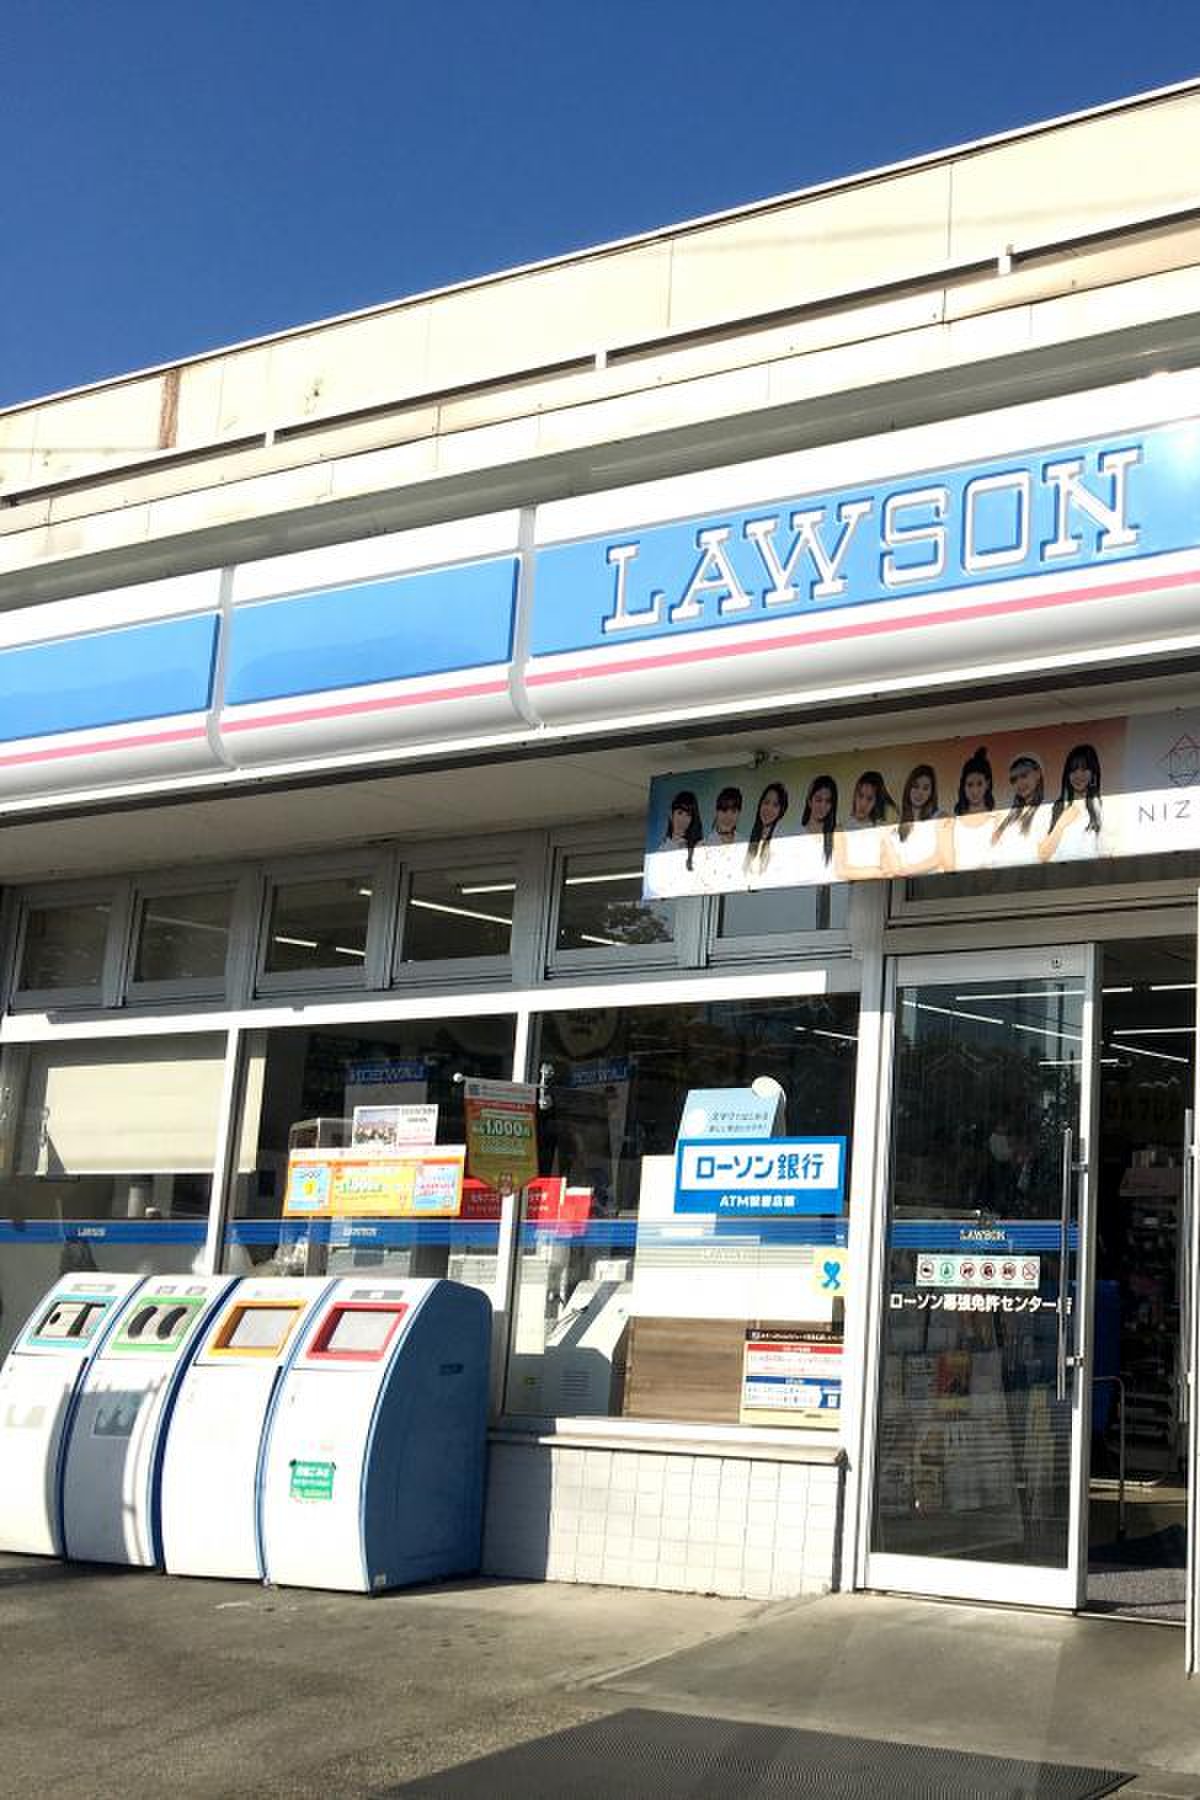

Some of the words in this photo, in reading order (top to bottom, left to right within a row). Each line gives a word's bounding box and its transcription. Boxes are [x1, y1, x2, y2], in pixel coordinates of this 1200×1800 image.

[602, 444, 1143, 633] LAWSON
[696, 1153, 824, 1180] ローソン銀行
